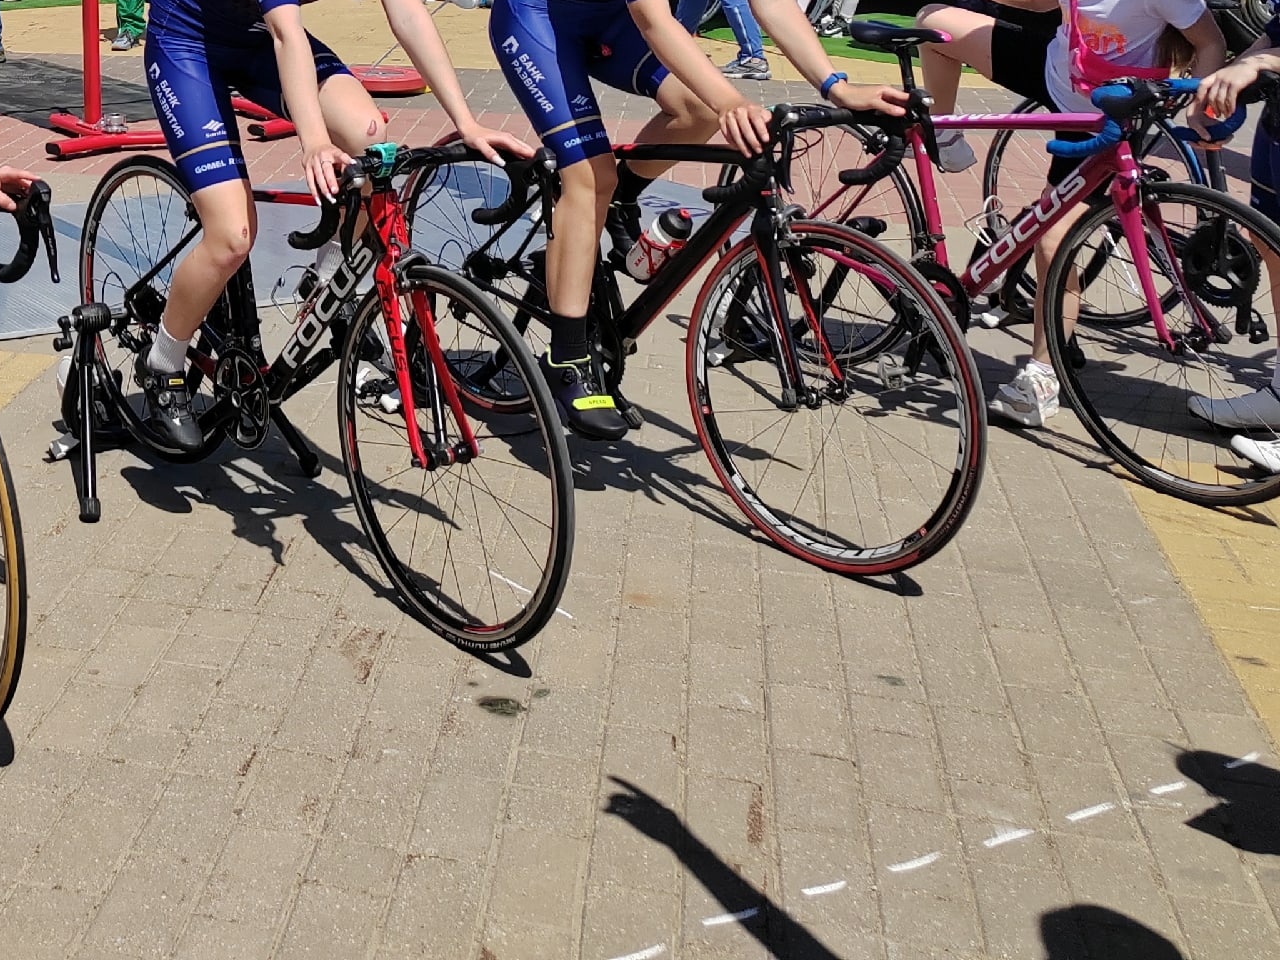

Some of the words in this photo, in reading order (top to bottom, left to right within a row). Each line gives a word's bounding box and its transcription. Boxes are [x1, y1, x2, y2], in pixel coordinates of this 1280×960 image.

[160, 79, 182, 109] БАНК
[511, 59, 556, 114] РАЗВИТИЯ
[519, 53, 546, 83] БАНК
[155, 86, 184, 140] РАЗВИТИЯ
[194, 159, 227, 175] GOMEL
[970, 171, 1087, 285] FOCUS
[282, 238, 374, 370] FOCUS
[375, 280, 408, 372] FOCUS
